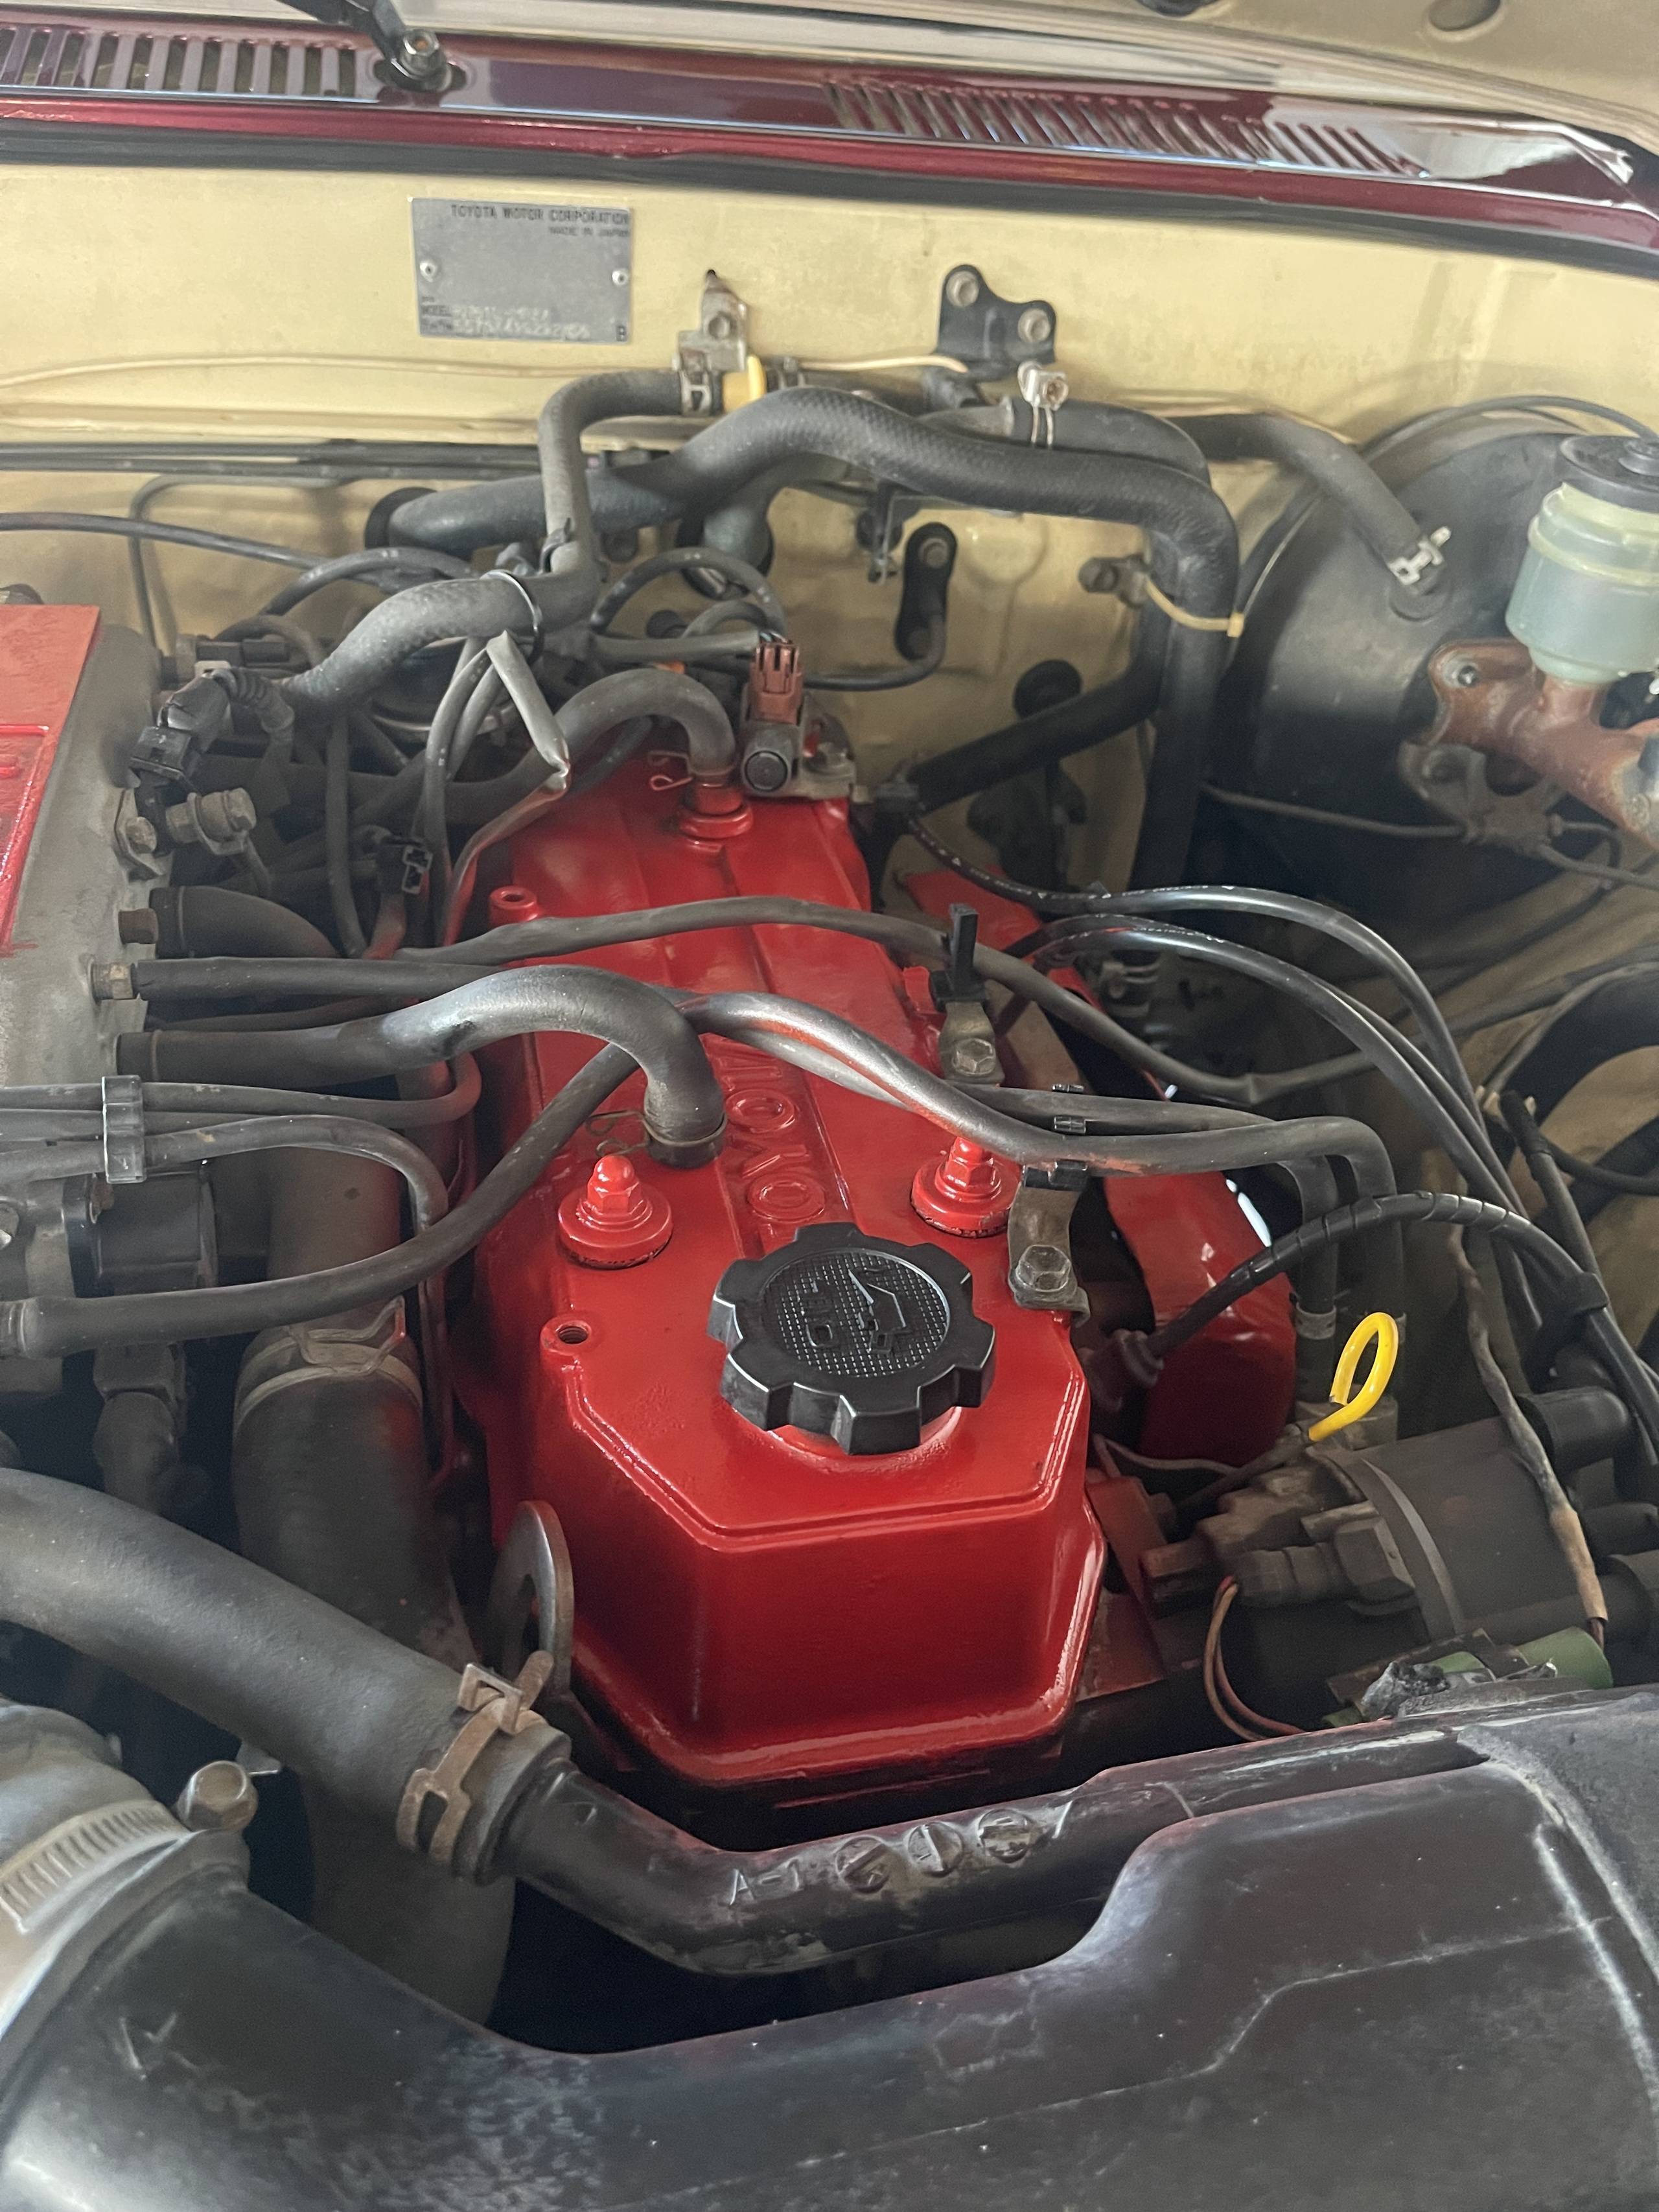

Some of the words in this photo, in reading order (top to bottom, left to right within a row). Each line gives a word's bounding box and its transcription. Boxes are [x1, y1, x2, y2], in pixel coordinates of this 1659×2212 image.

[450, 203, 497, 219] TOYOTA
[502, 206, 544, 221] MOTOR
[550, 208, 629, 226] CORPORATION
